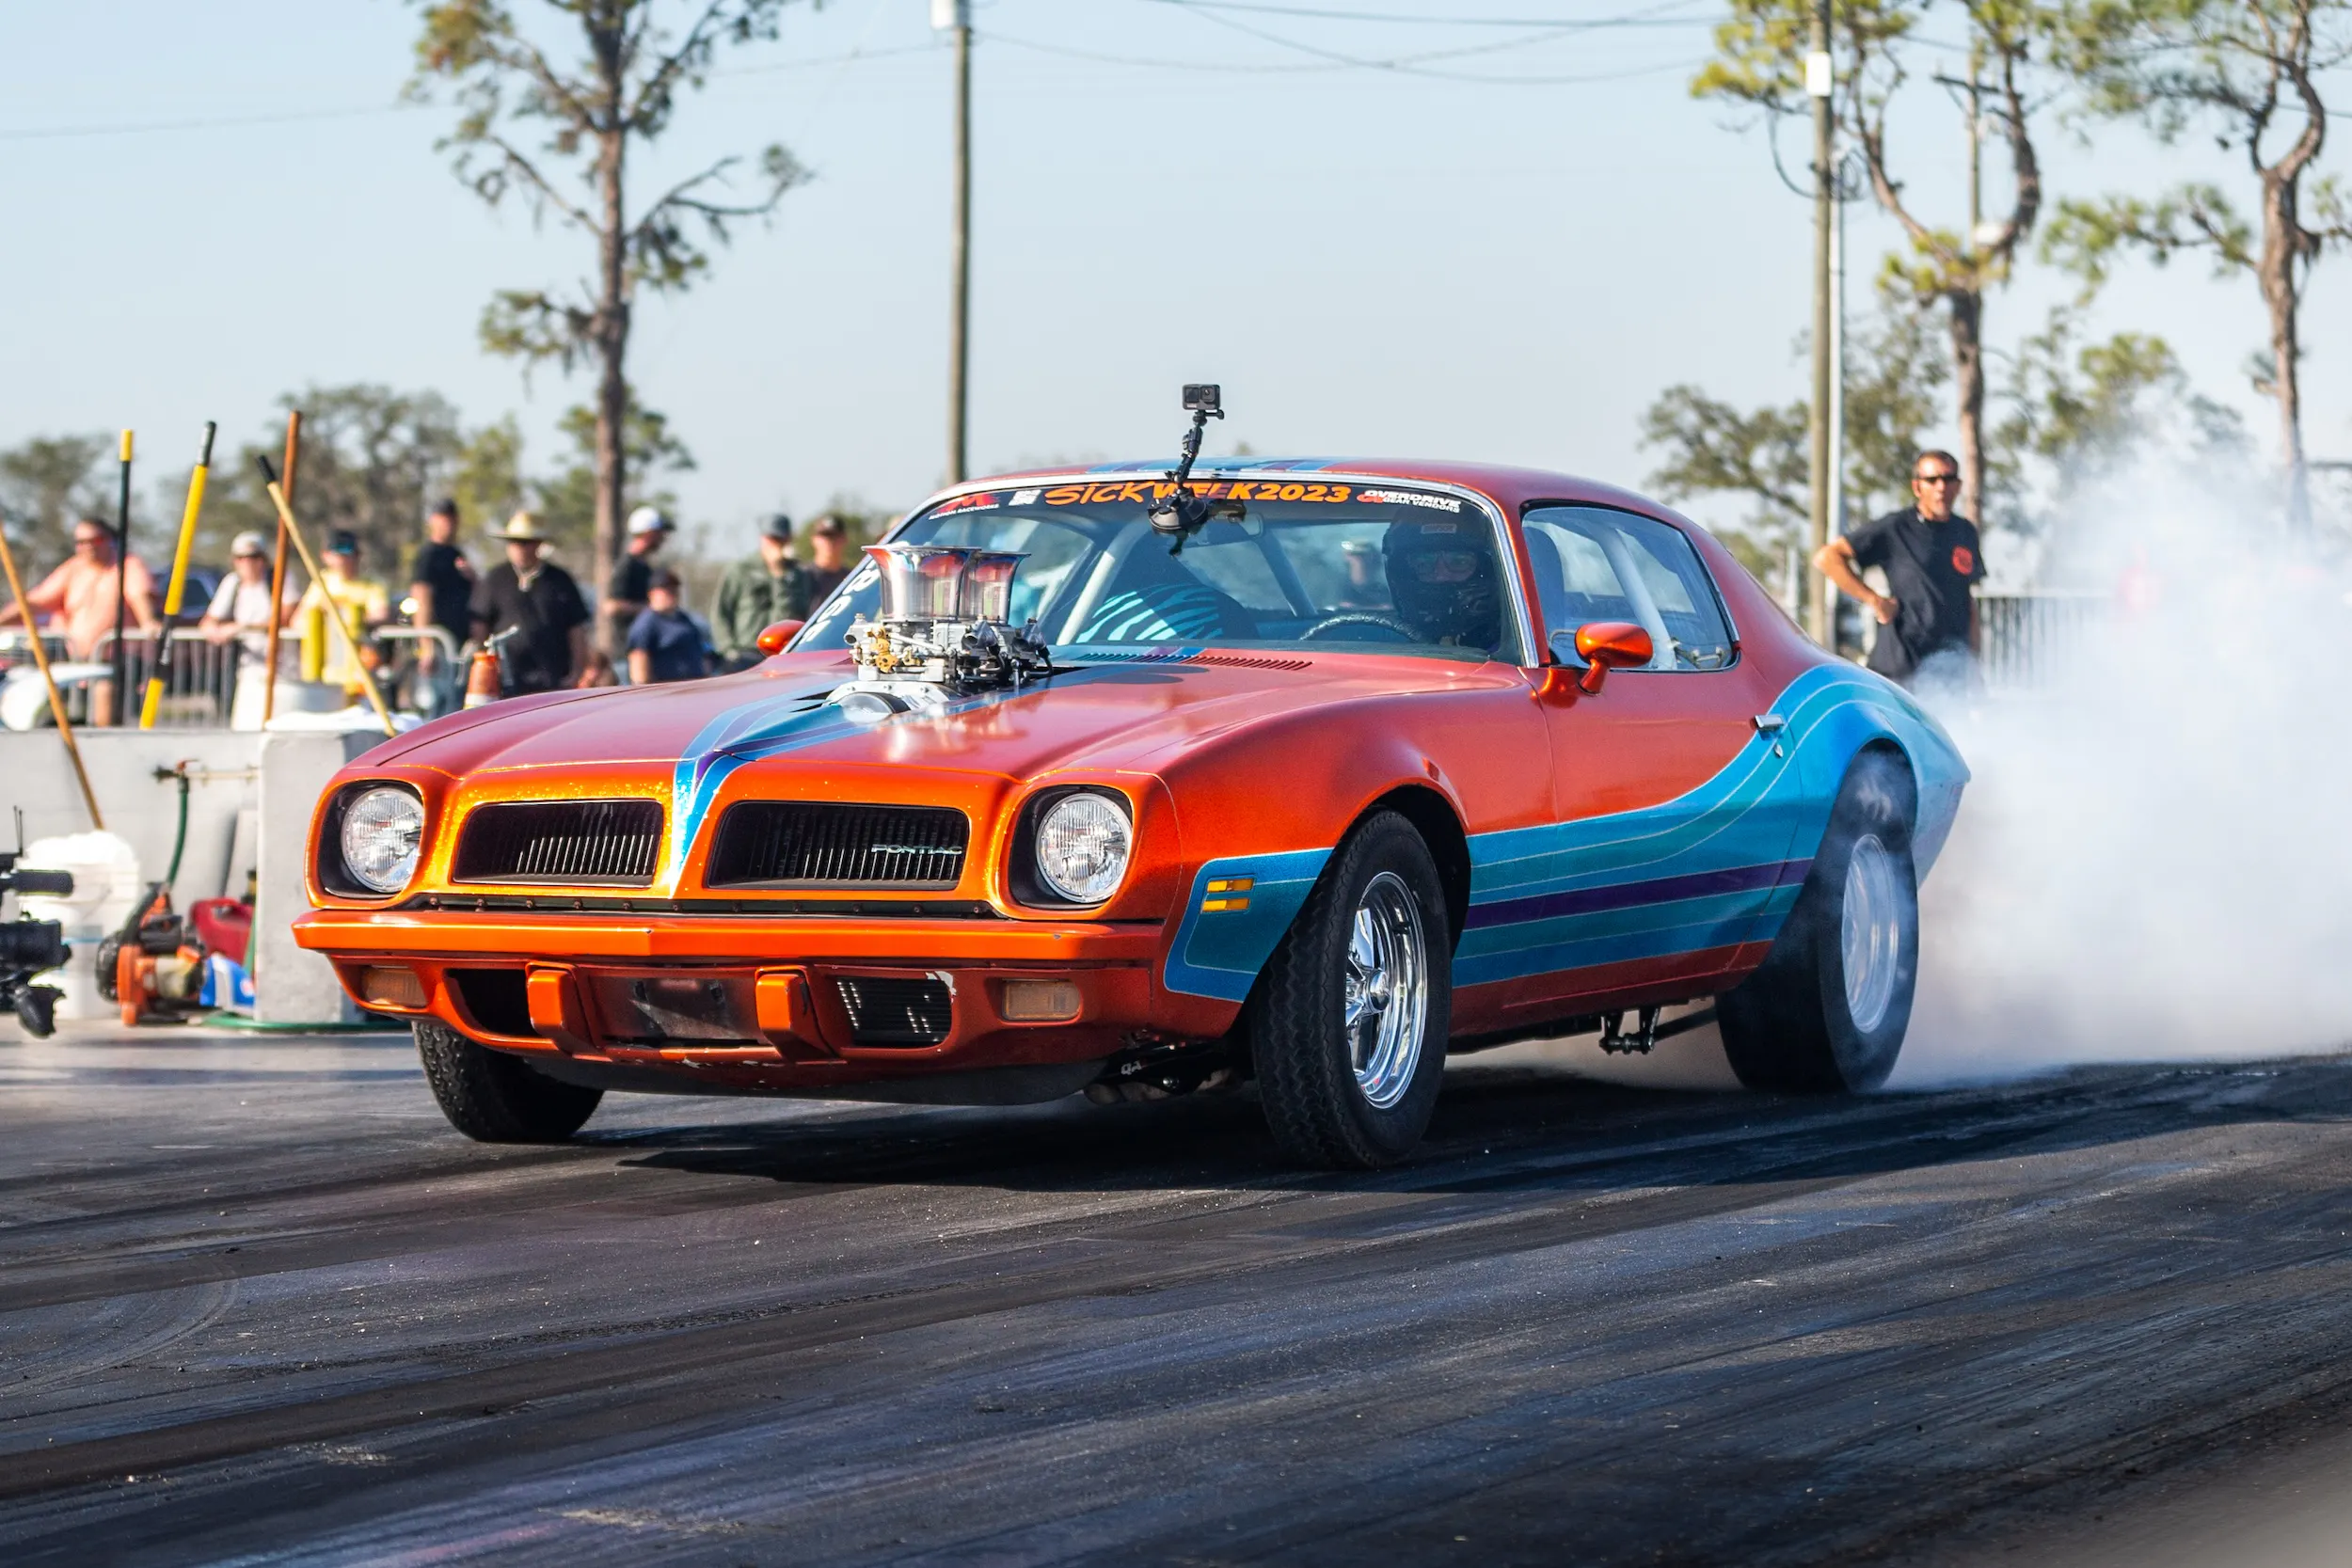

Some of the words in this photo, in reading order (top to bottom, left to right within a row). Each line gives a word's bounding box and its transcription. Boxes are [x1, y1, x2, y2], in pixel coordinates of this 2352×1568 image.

[1364, 489, 1461, 508] OVERDRIVE
[1384, 497, 1410, 506] GEAR
[1412, 499, 1460, 514] VENDORS
[871, 844, 962, 855] PONTIAC
